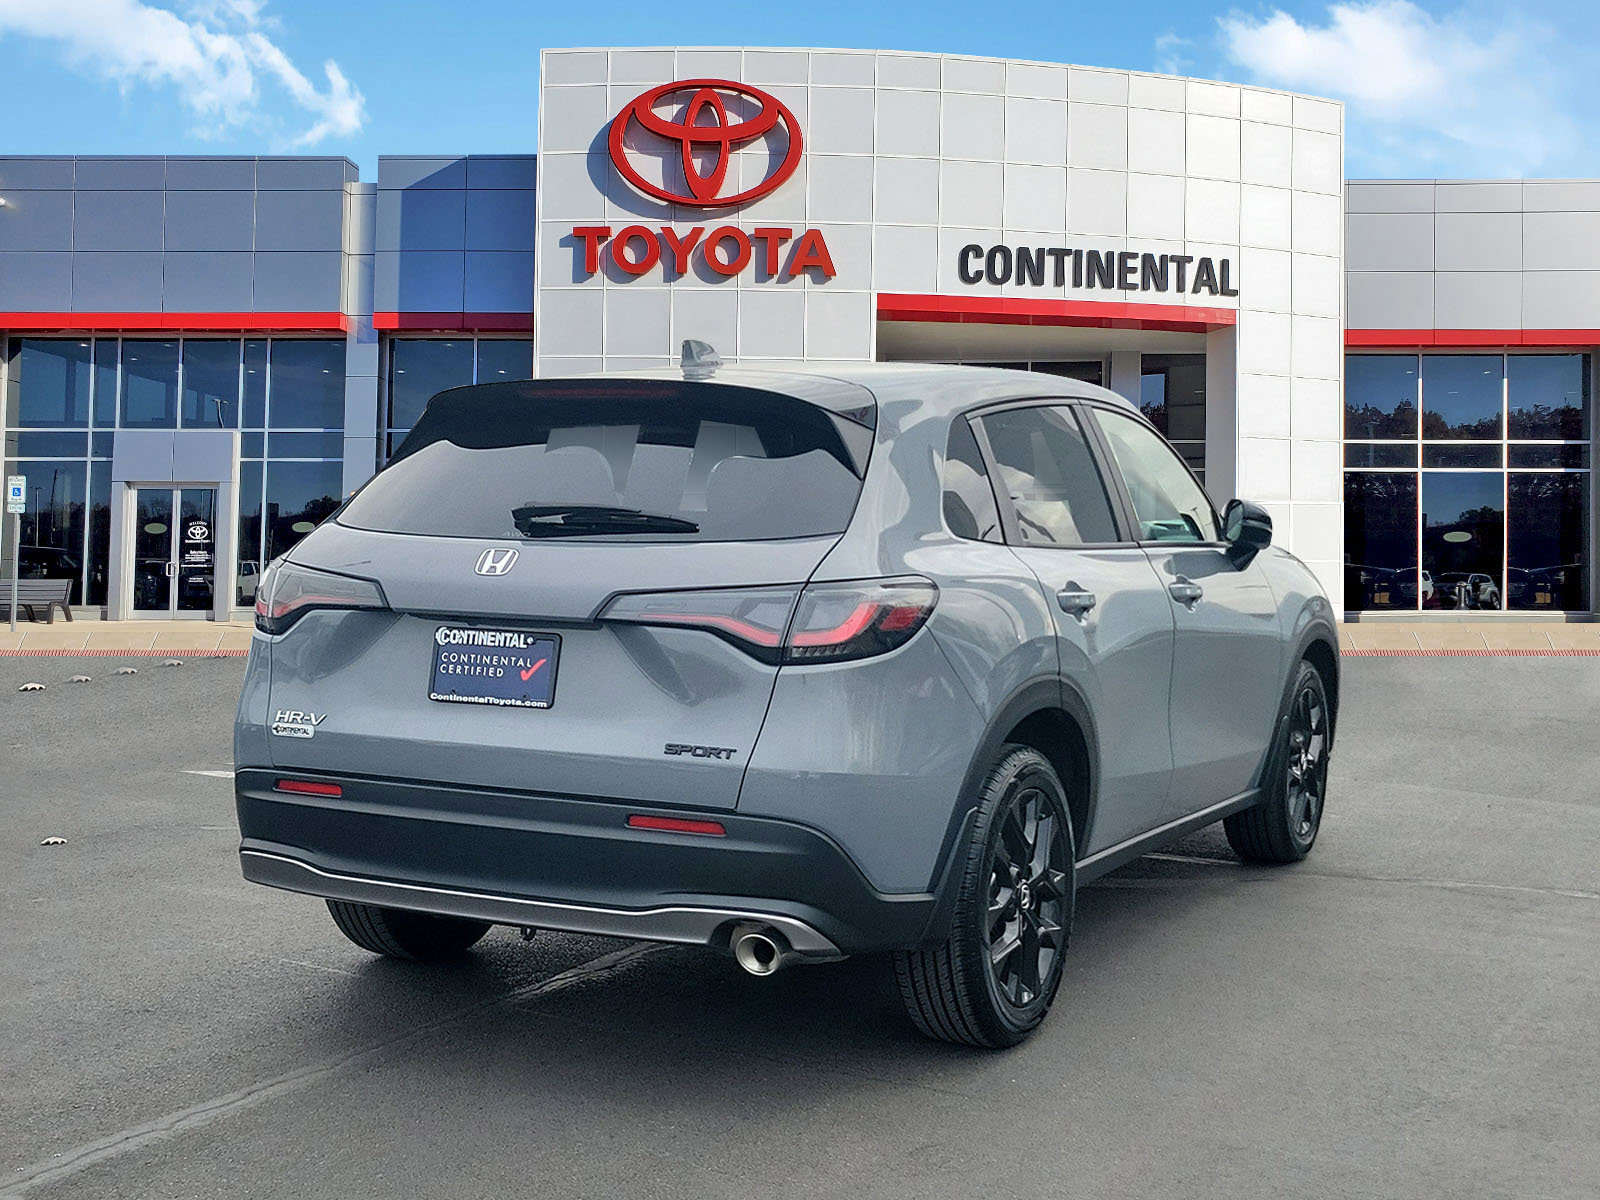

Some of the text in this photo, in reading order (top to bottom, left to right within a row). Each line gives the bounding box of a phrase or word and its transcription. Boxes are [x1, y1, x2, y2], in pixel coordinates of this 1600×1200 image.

[572, 225, 837, 277] TOYOTA
[958, 244, 1239, 297] CONTINENTAL
[436, 627, 527, 648] CONTINENTAL
[441, 652, 533, 668] CONTINENTAL
[439, 663, 504, 678] CERTIFIED
[430, 692, 548, 708] ContinentalToyota.com
[275, 710, 328, 726] HR-V
[664, 743, 737, 760] SPORT
